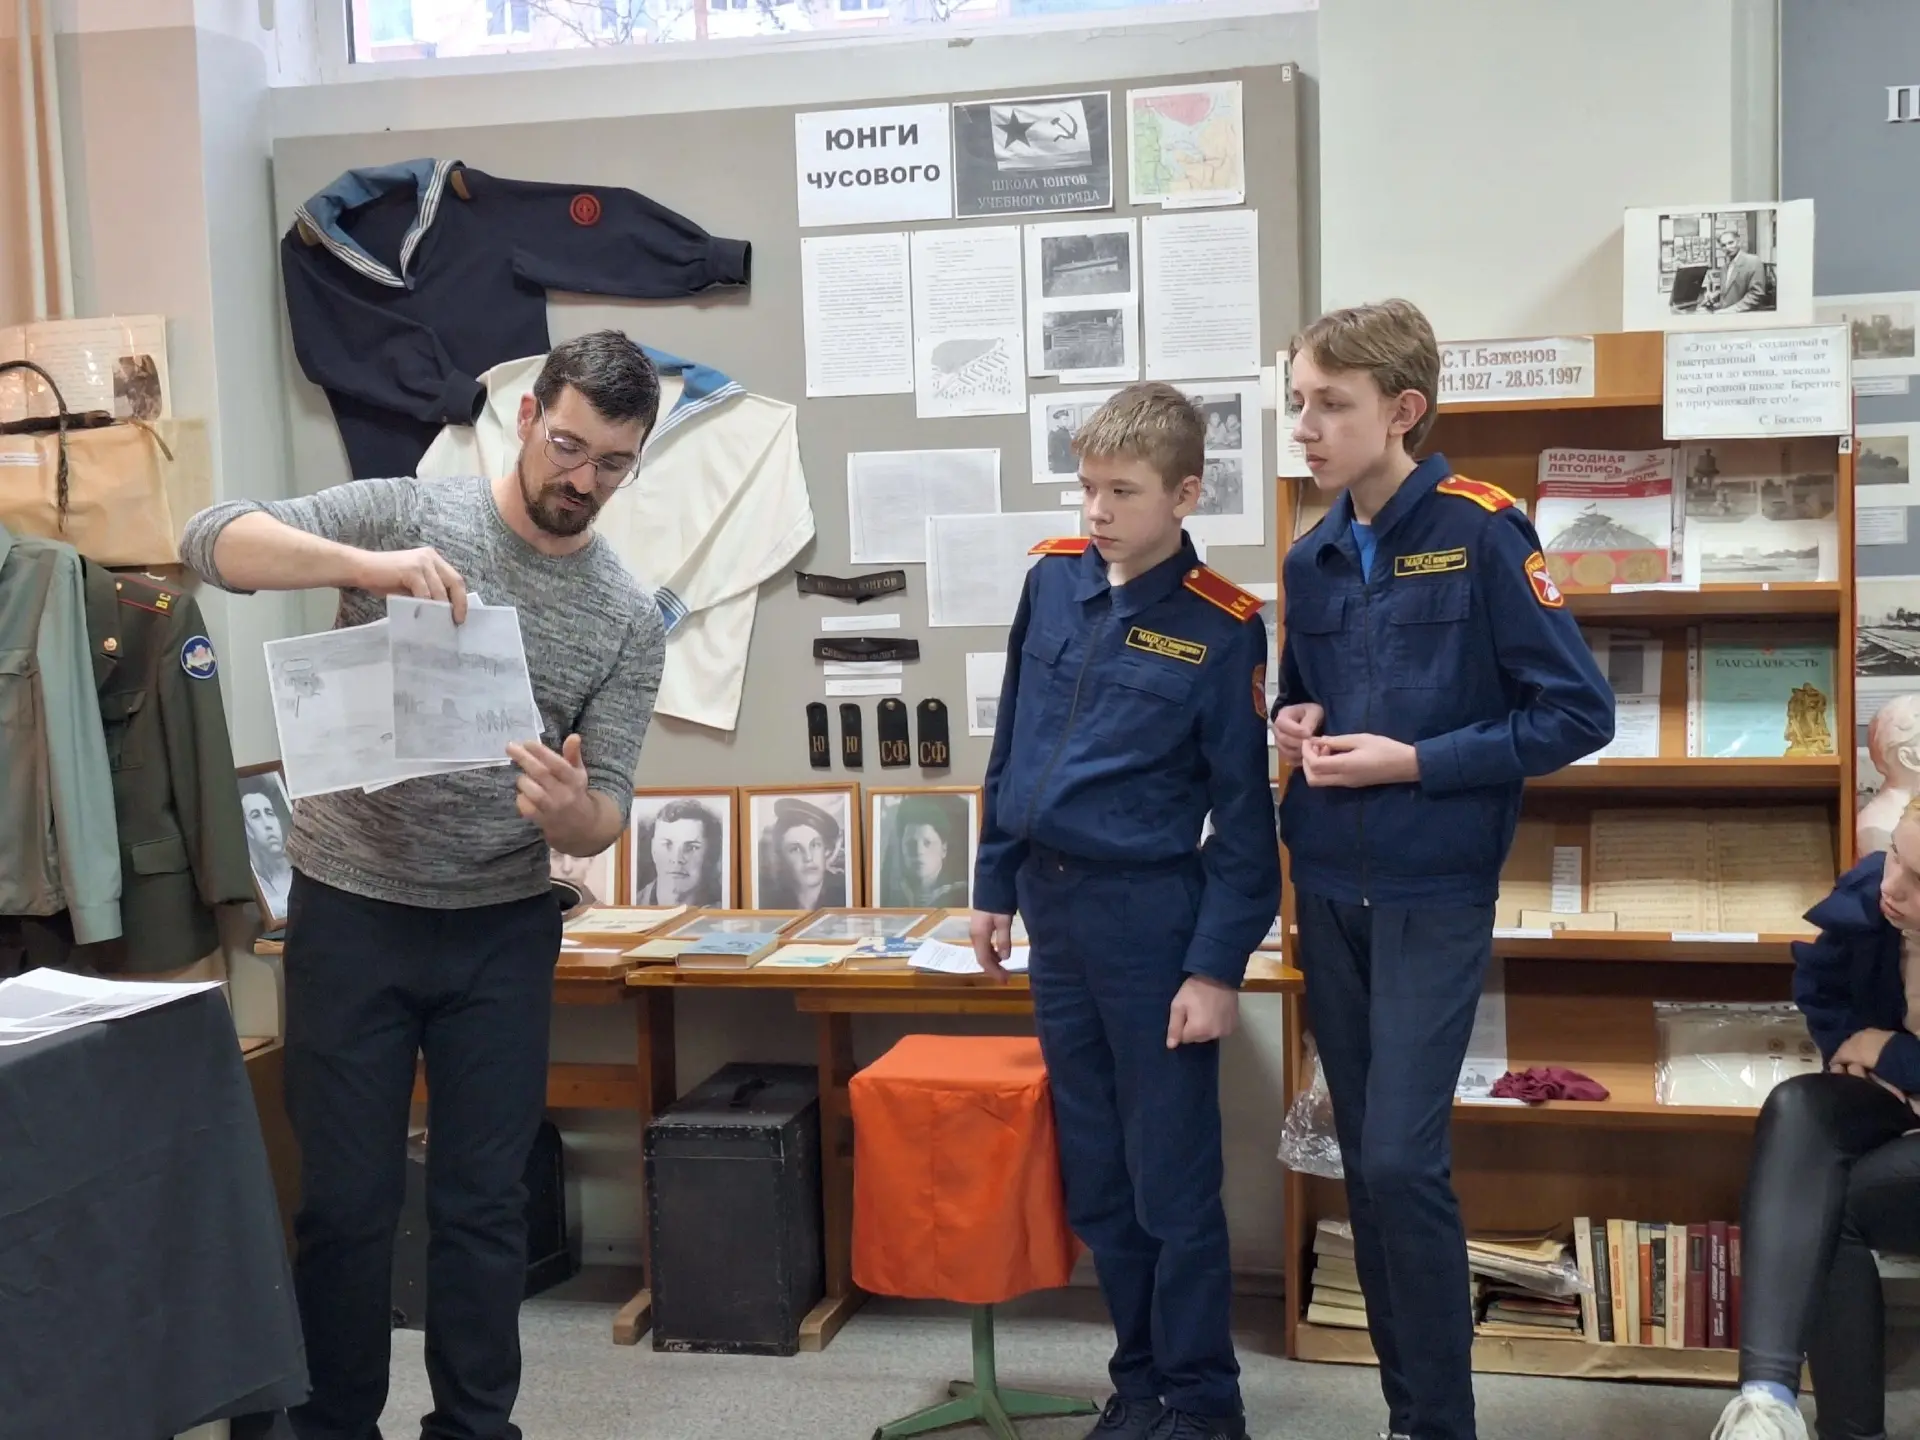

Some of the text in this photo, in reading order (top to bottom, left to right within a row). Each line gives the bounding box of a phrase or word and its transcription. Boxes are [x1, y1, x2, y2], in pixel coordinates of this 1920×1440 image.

[825, 124, 918, 151] ЮНГИ
[807, 164, 940, 189] ЧУСОВОГО
[992, 174, 1088, 191] ШКОЛА ЮНГОВ
[978, 190, 1100, 209] УЧЕБНОГО ОТРЯДА
[1505, 367, 1582, 388] 28.05.1997
[1706, 382, 1746, 396] родной
[1791, 379, 1841, 391] Берегите
[1774, 413, 1822, 425] Баженов
[1841, 439, 1850, 451] 4
[1548, 453, 1625, 463] НАРОДНАЯ
[1548, 463, 1622, 474] ЛЕТОПИСЬ
[1715, 659, 1818, 669] БЛАГОДАРНОСТЬ
[812, 736, 825, 752] Ю
[846, 736, 858, 752] Ю
[881, 740, 908, 762] СФ
[920, 740, 947, 763] СФ
